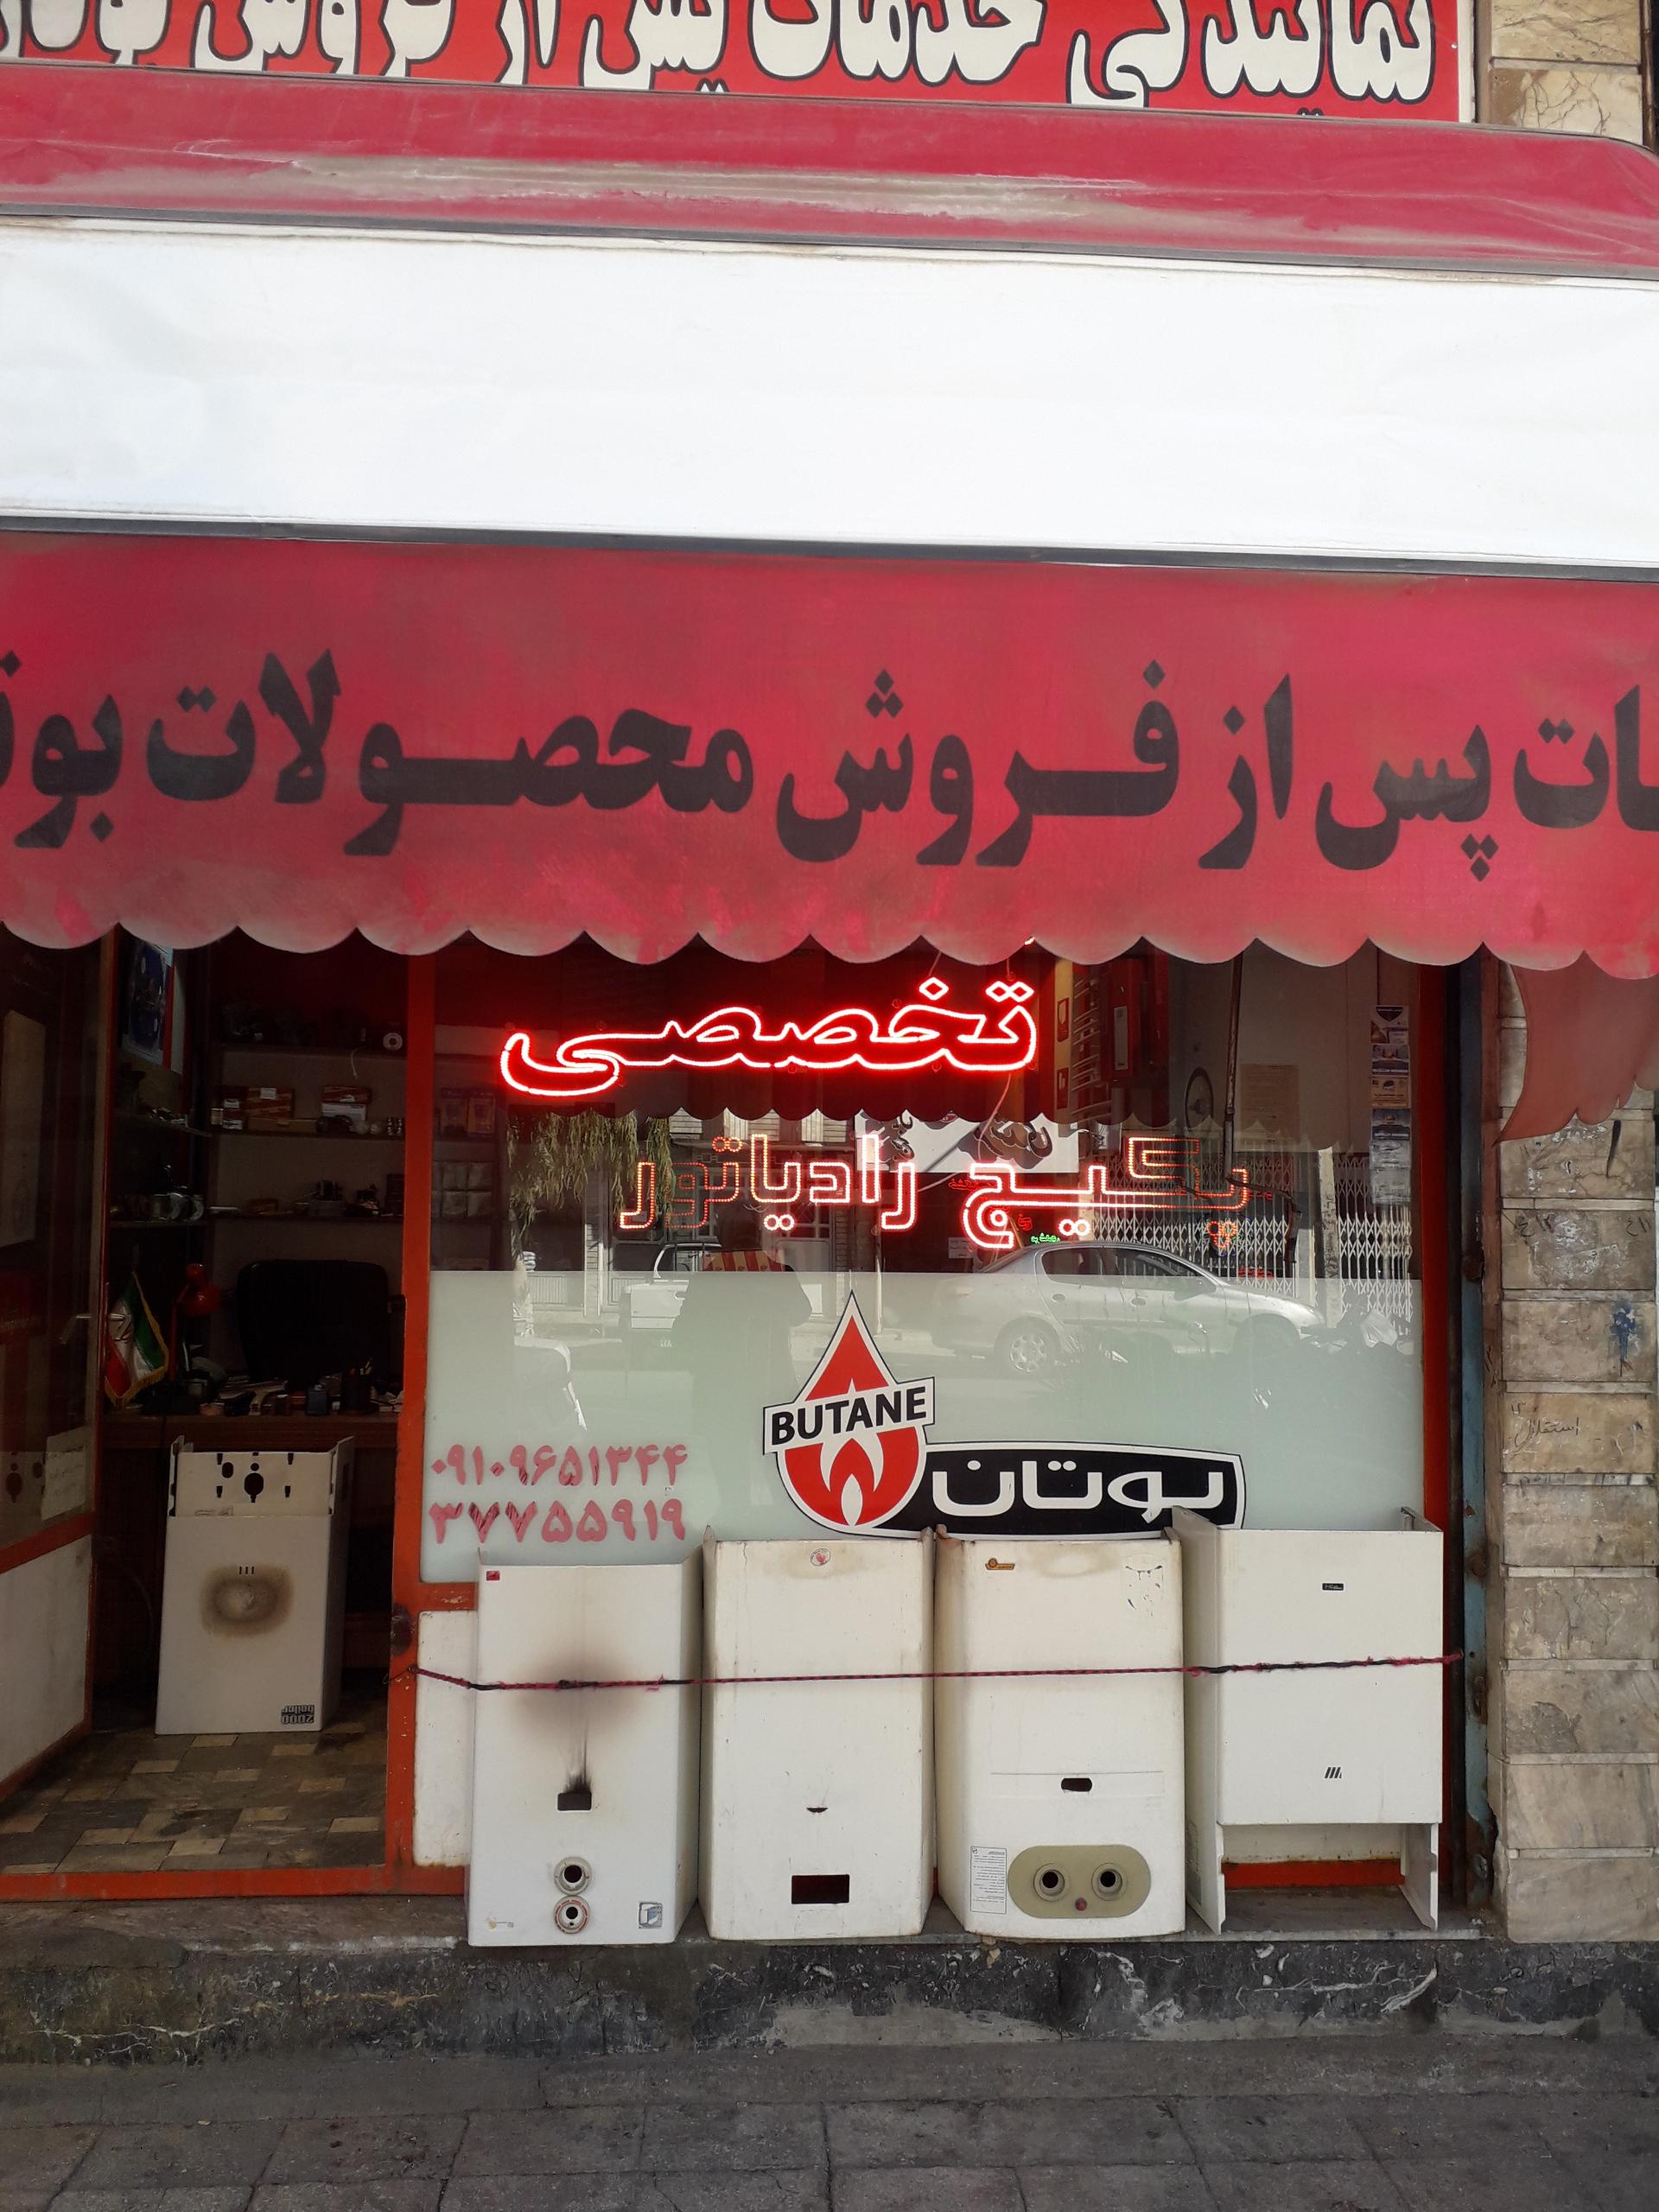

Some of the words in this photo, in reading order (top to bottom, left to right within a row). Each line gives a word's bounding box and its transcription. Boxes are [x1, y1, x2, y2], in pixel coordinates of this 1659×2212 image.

[144, 648, 754, 856] محصولات
[775, 658, 1180, 868] فروش
[1198, 672, 1294, 870] از
[1314, 723, 1500, 882] پس
[499, 976, 1037, 1097] تخصصی
[619, 1133, 918, 1231] رادیاتور
[963, 1135, 1249, 1249] پکیج
[430, 1444, 689, 1487] ۰۹۱۰۹۶۵۱۳۴۴
[771, 1385, 928, 1446] BUTANE
[428, 1498, 686, 1545] ۳۷۷۵۵۹۱۹
[932, 1459, 1224, 1524] بوتان
